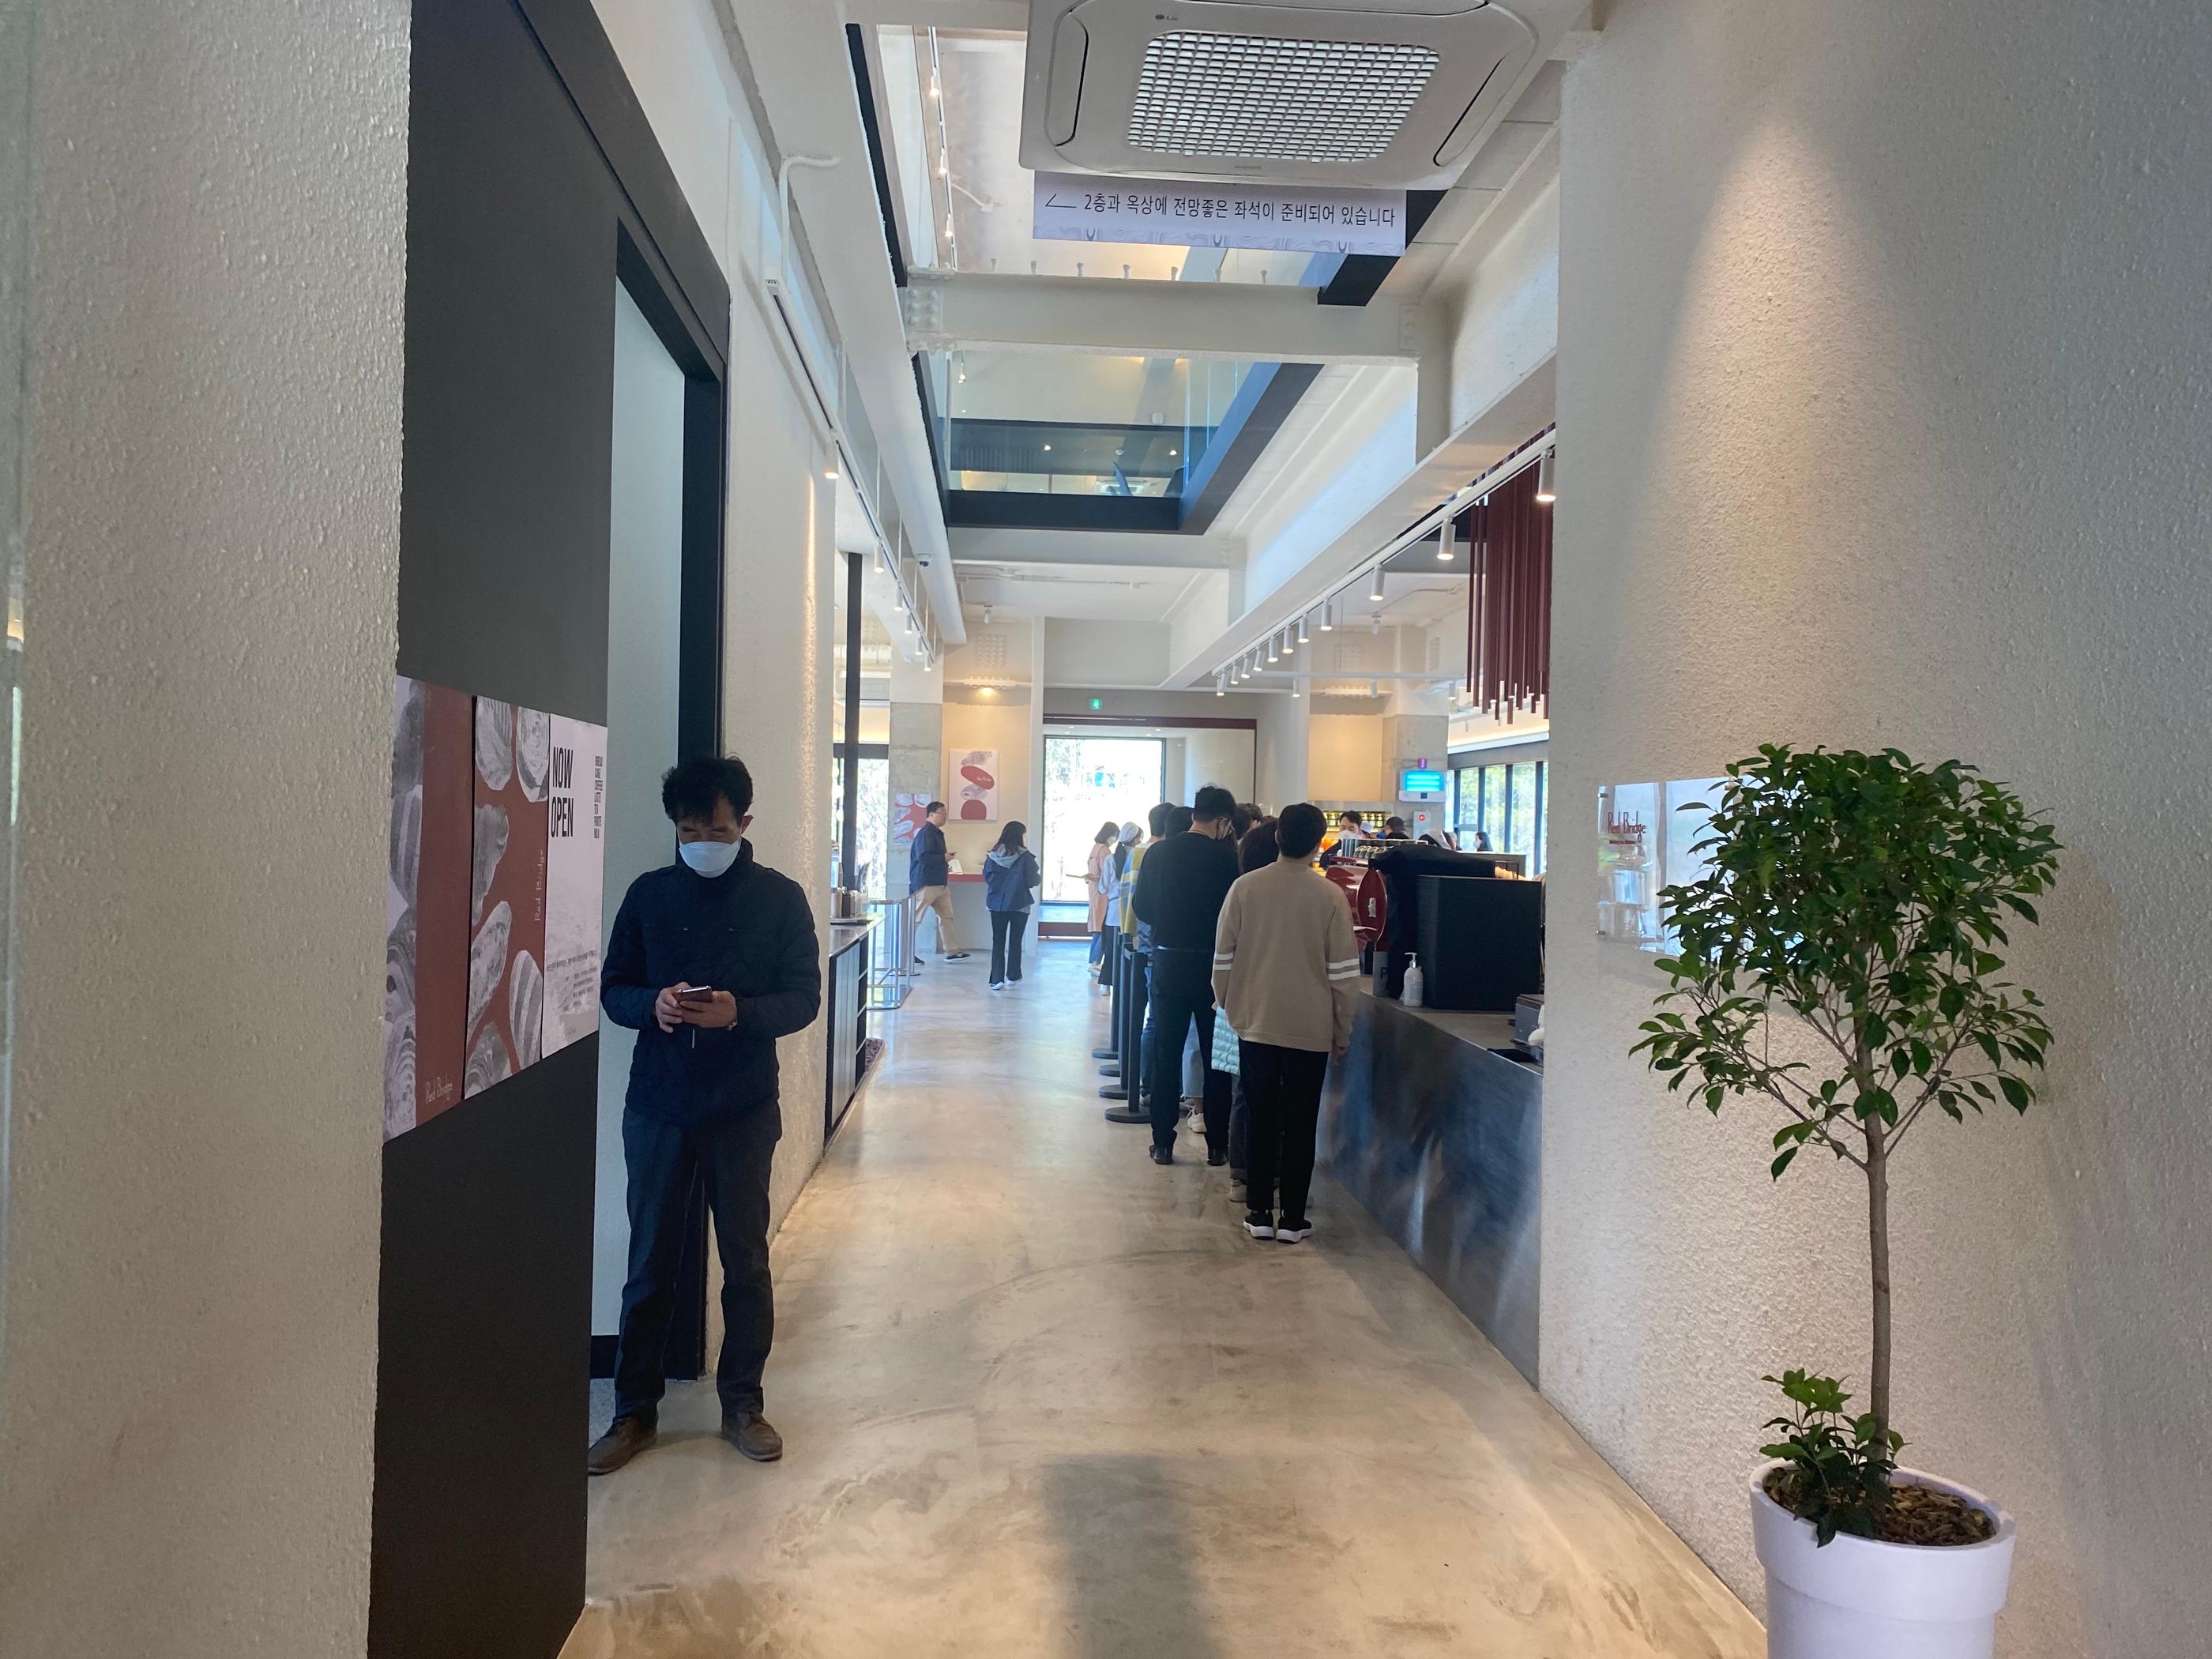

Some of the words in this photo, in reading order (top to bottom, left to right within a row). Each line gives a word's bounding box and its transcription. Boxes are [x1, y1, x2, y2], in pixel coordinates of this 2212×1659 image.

[1085, 193, 1120, 213] 2층과
[1127, 194, 1167, 215] 옥상에
[1174, 197, 1228, 218] 전망좋은
[1234, 200, 1274, 220] 좌석이
[1281, 203, 1335, 224] 준비되어
[1341, 206, 1395, 227] 있습니다
[553, 747, 574, 788] NOW
[551, 796, 574, 837] OPEN
